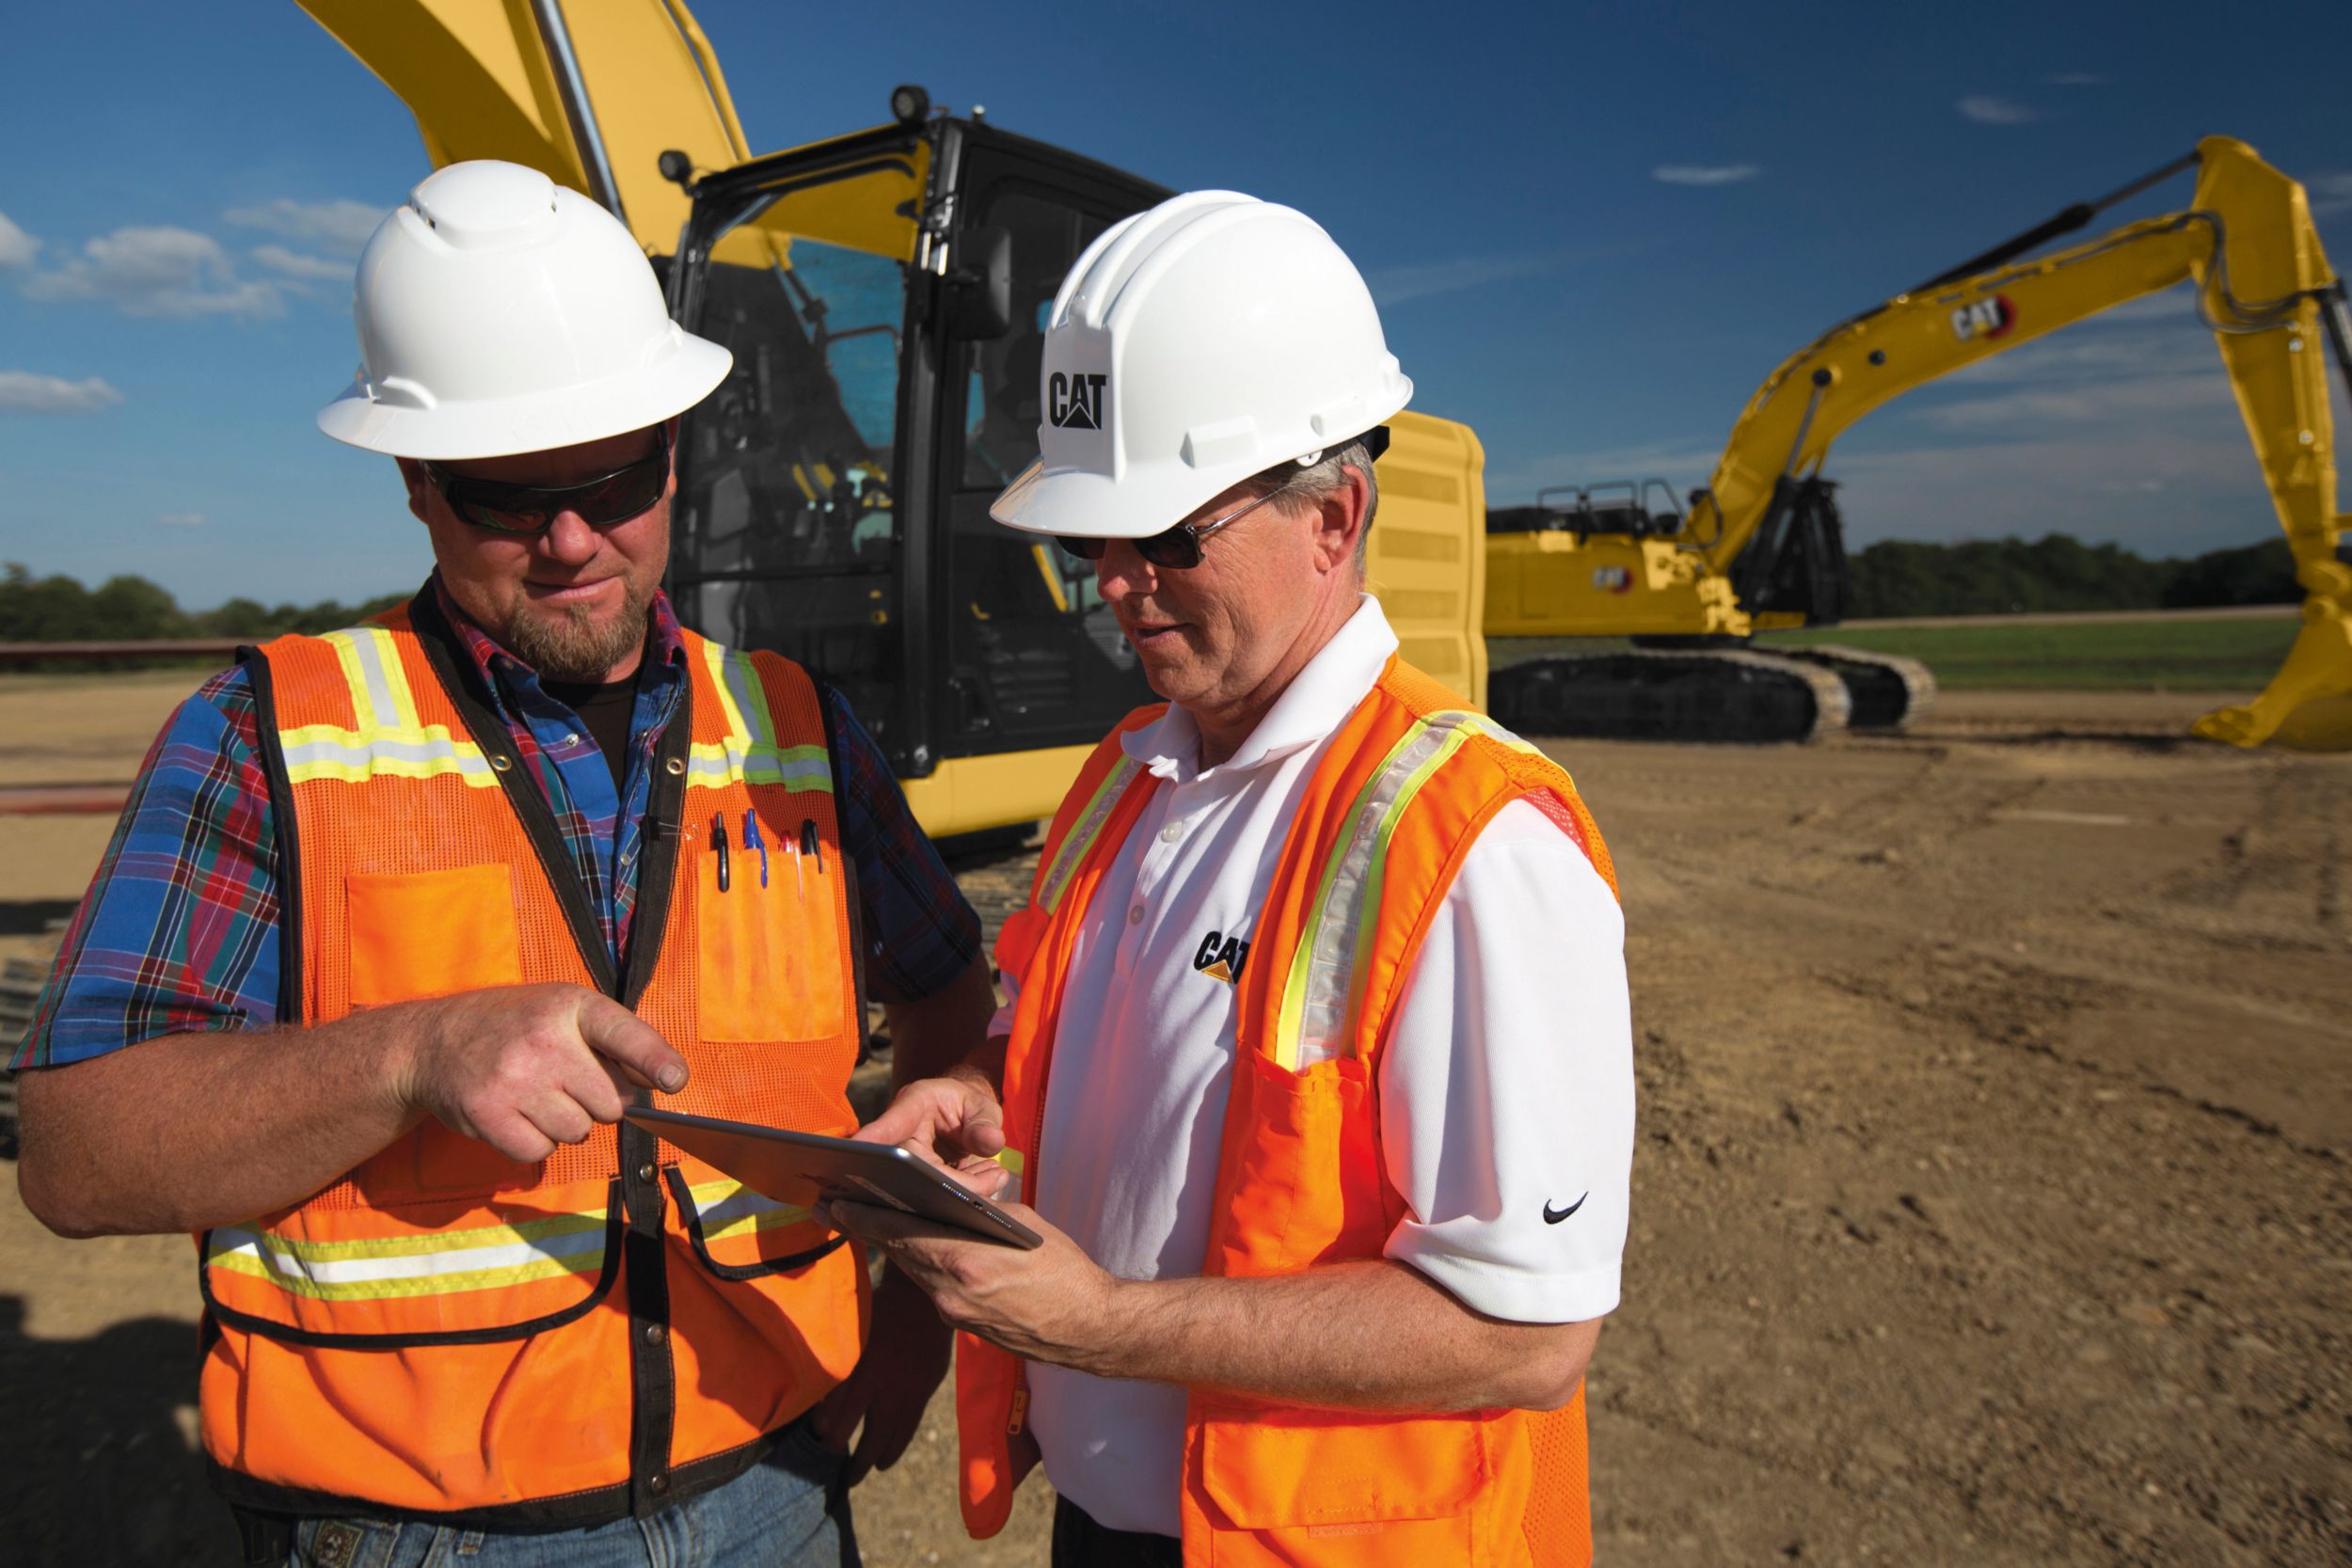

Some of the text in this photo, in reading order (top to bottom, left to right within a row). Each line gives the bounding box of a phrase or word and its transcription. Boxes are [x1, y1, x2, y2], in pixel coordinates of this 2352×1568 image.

[1951, 297, 2000, 340] CAT
[1049, 372, 1107, 430] CAT
[1193, 930, 1250, 985] CAT
